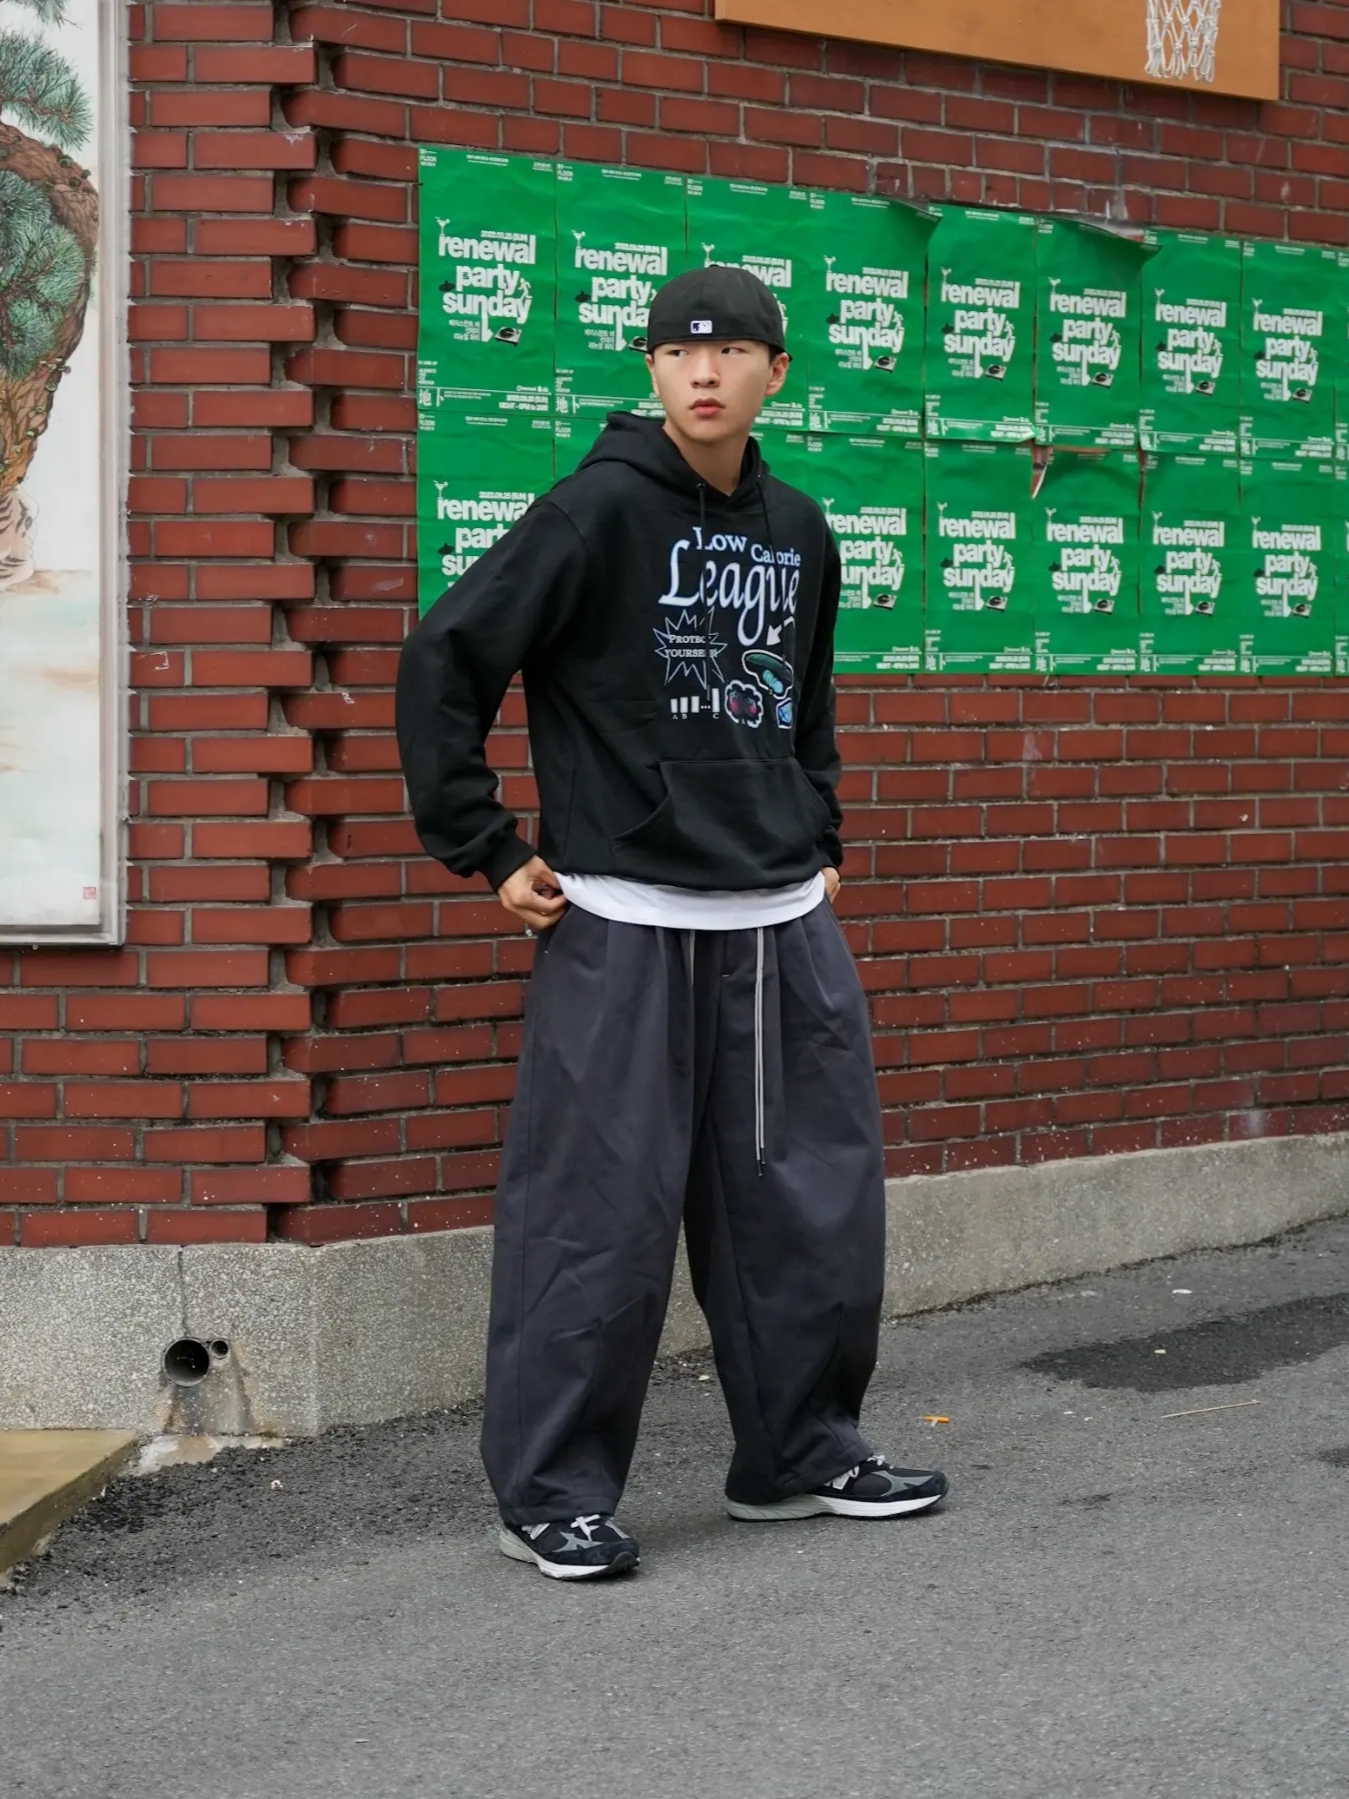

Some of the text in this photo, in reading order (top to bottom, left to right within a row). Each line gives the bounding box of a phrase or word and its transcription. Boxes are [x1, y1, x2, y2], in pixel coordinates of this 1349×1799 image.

[439, 234, 536, 264] renewal
[575, 246, 668, 275] renewal
[456, 264, 520, 295] party
[592, 275, 652, 306] party
[826, 271, 909, 298] renewal
[443, 290, 532, 324] sunday
[941, 281, 1020, 308] renewal
[1050, 292, 1126, 318] renewal
[579, 300, 649, 327] sunda
[840, 297, 894, 327] party
[954, 308, 1006, 336] party
[1155, 302, 1227, 327] renewal
[1253, 311, 1323, 336] renewal
[829, 322, 905, 353] sunday
[1063, 317, 1113, 345] party
[1167, 326, 1215, 354] party
[944, 331, 1015, 362] sunday
[1052, 340, 1121, 370] sunday
[1265, 335, 1311, 362] party
[1158, 349, 1223, 378] sunday
[1256, 357, 1319, 386] sunday
[455, 523, 509, 553] part
[692, 526, 747, 553] Low
[939, 512, 1016, 539] renewal
[1046, 517, 1124, 544] renewal
[1153, 521, 1225, 547] renewal
[1252, 526, 1321, 551] renewal
[840, 536, 893, 565] party
[953, 540, 1004, 568] party
[1060, 543, 1111, 572] party
[1166, 547, 1212, 575] party
[1265, 551, 1310, 578] party
[841, 560, 905, 590] unday
[943, 563, 1015, 593] sunday
[1052, 569, 1122, 596] sunday
[1157, 570, 1222, 598] sunday
[1256, 574, 1318, 601] sunday
[658, 539, 799, 646] League
[669, 634, 712, 644] PROTEC
